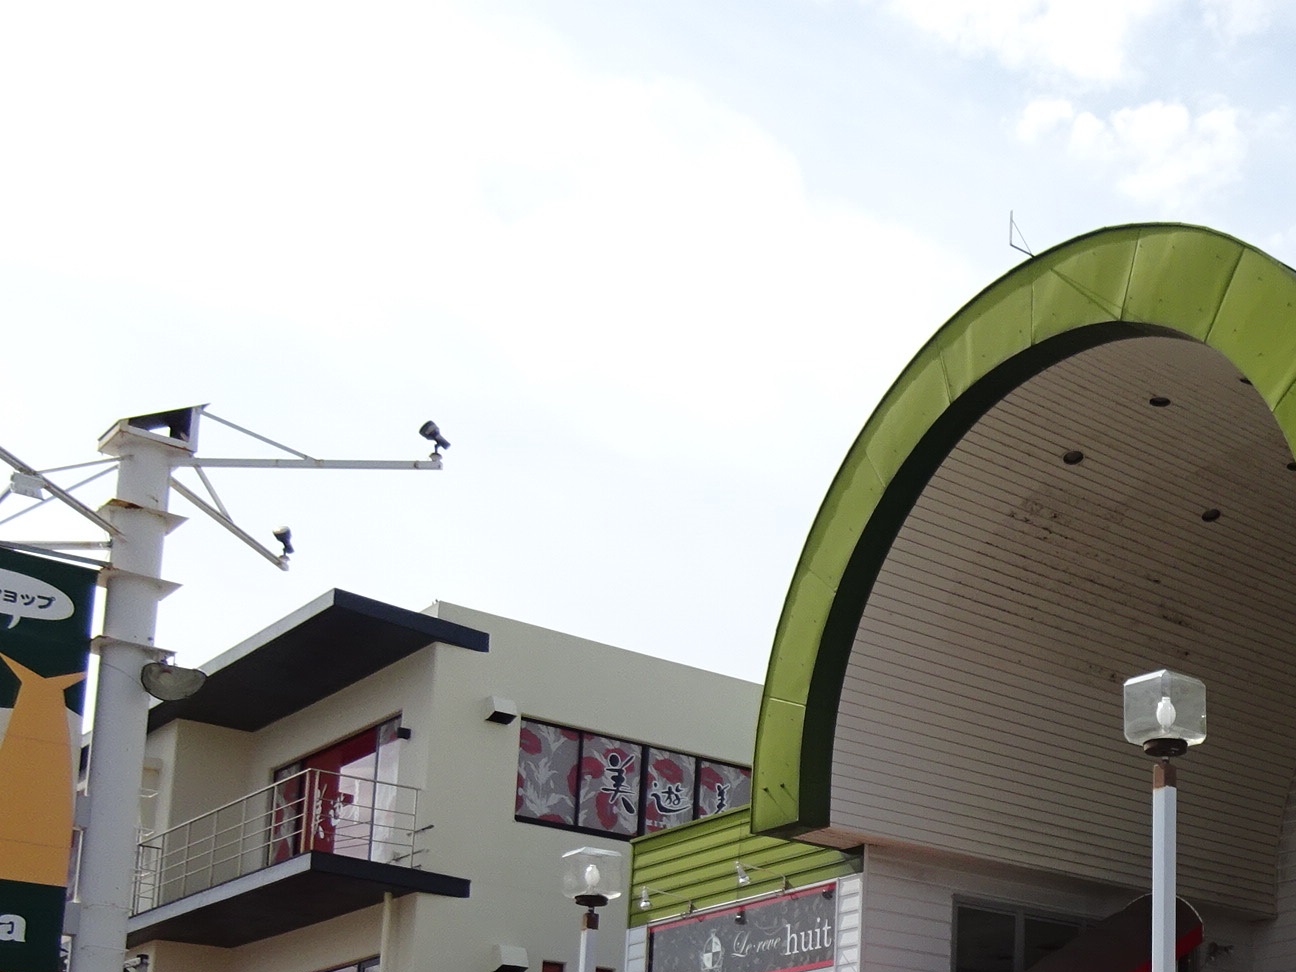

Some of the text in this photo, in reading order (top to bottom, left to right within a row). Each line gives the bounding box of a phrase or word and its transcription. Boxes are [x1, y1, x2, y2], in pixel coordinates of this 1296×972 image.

[0, 590, 56, 609] ョップ
[785, 917, 832, 956] huit
